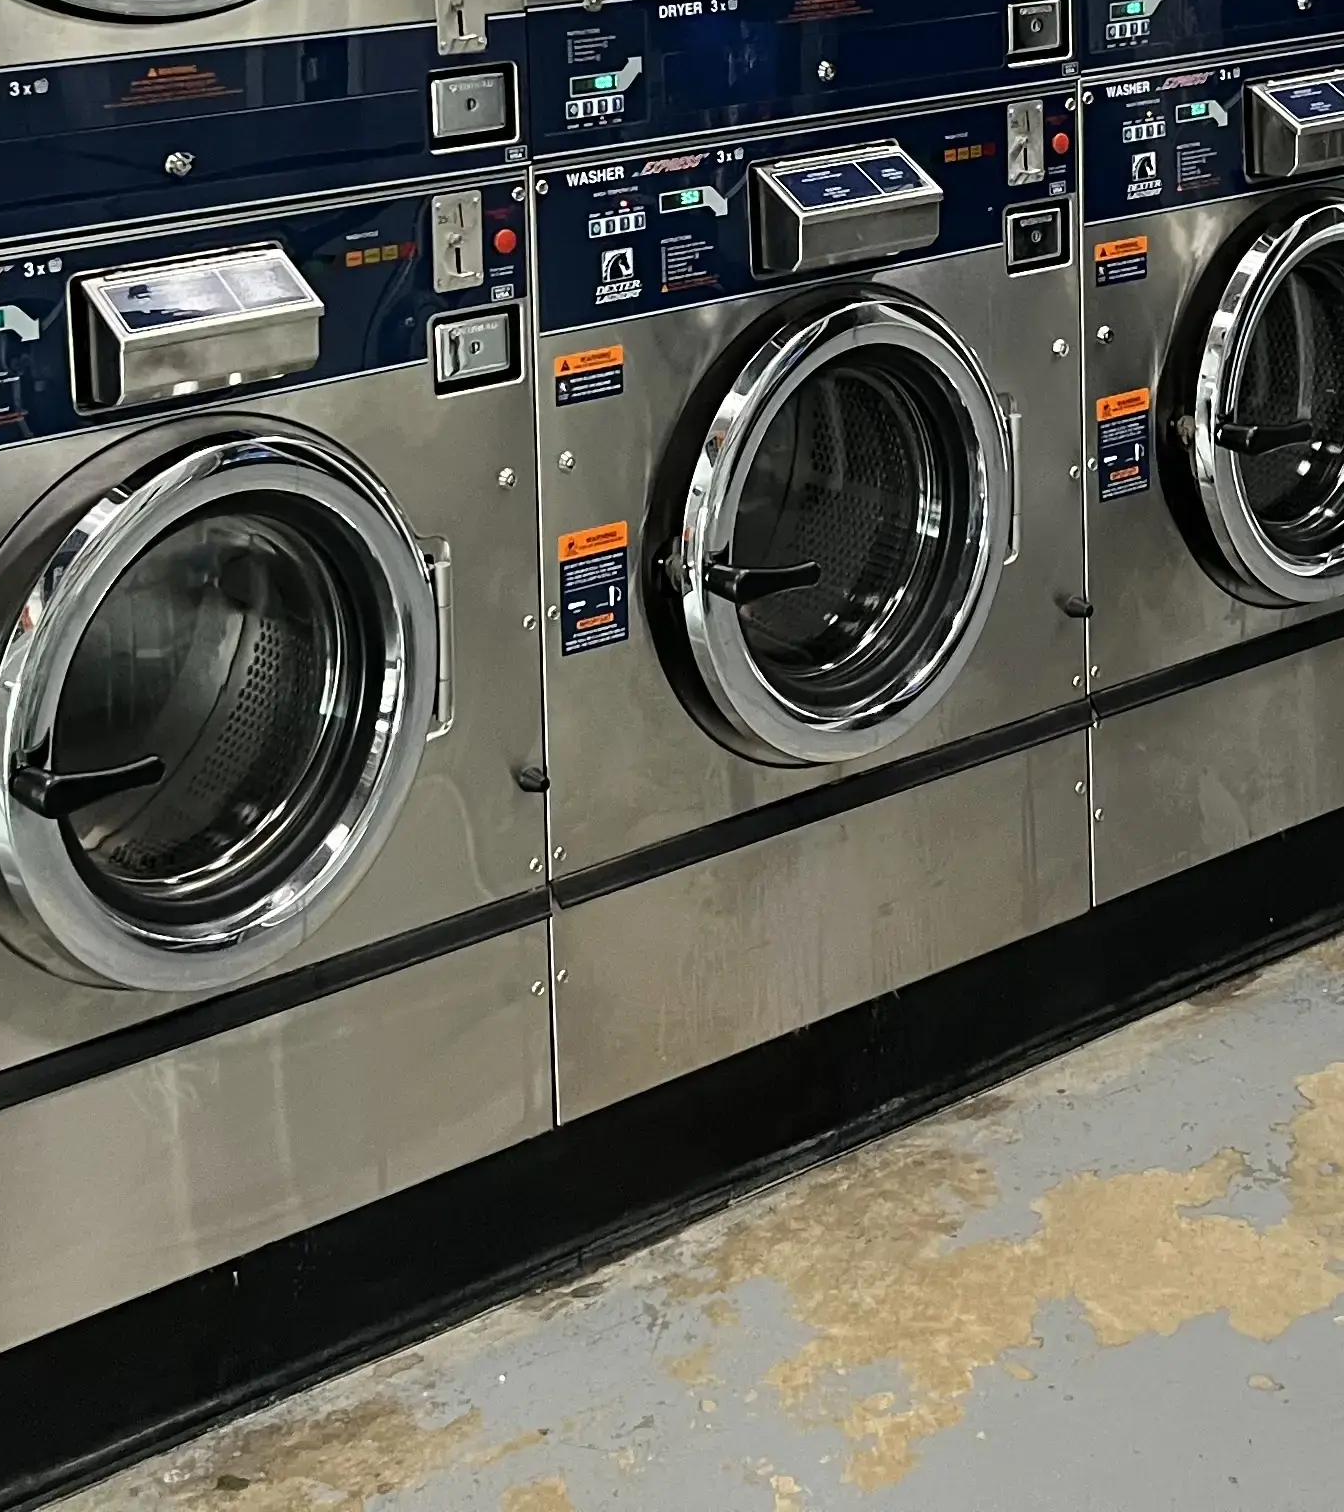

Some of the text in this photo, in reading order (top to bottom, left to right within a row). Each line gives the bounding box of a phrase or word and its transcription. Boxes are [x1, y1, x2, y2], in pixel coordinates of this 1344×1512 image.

[658, 0, 703, 19] DRYER
[710, 0, 718, 13] 3
[9, 81, 21, 97] 3
[23, 84, 32, 96] x
[1106, 81, 1151, 98] WASHER
[1219, 68, 1226, 81] 3
[566, 166, 625, 187] WASHER
[716, 150, 725, 164] 3
[23, 263, 35, 277] 3
[37, 265, 45, 276] x
[596, 280, 641, 297] DEXTER
